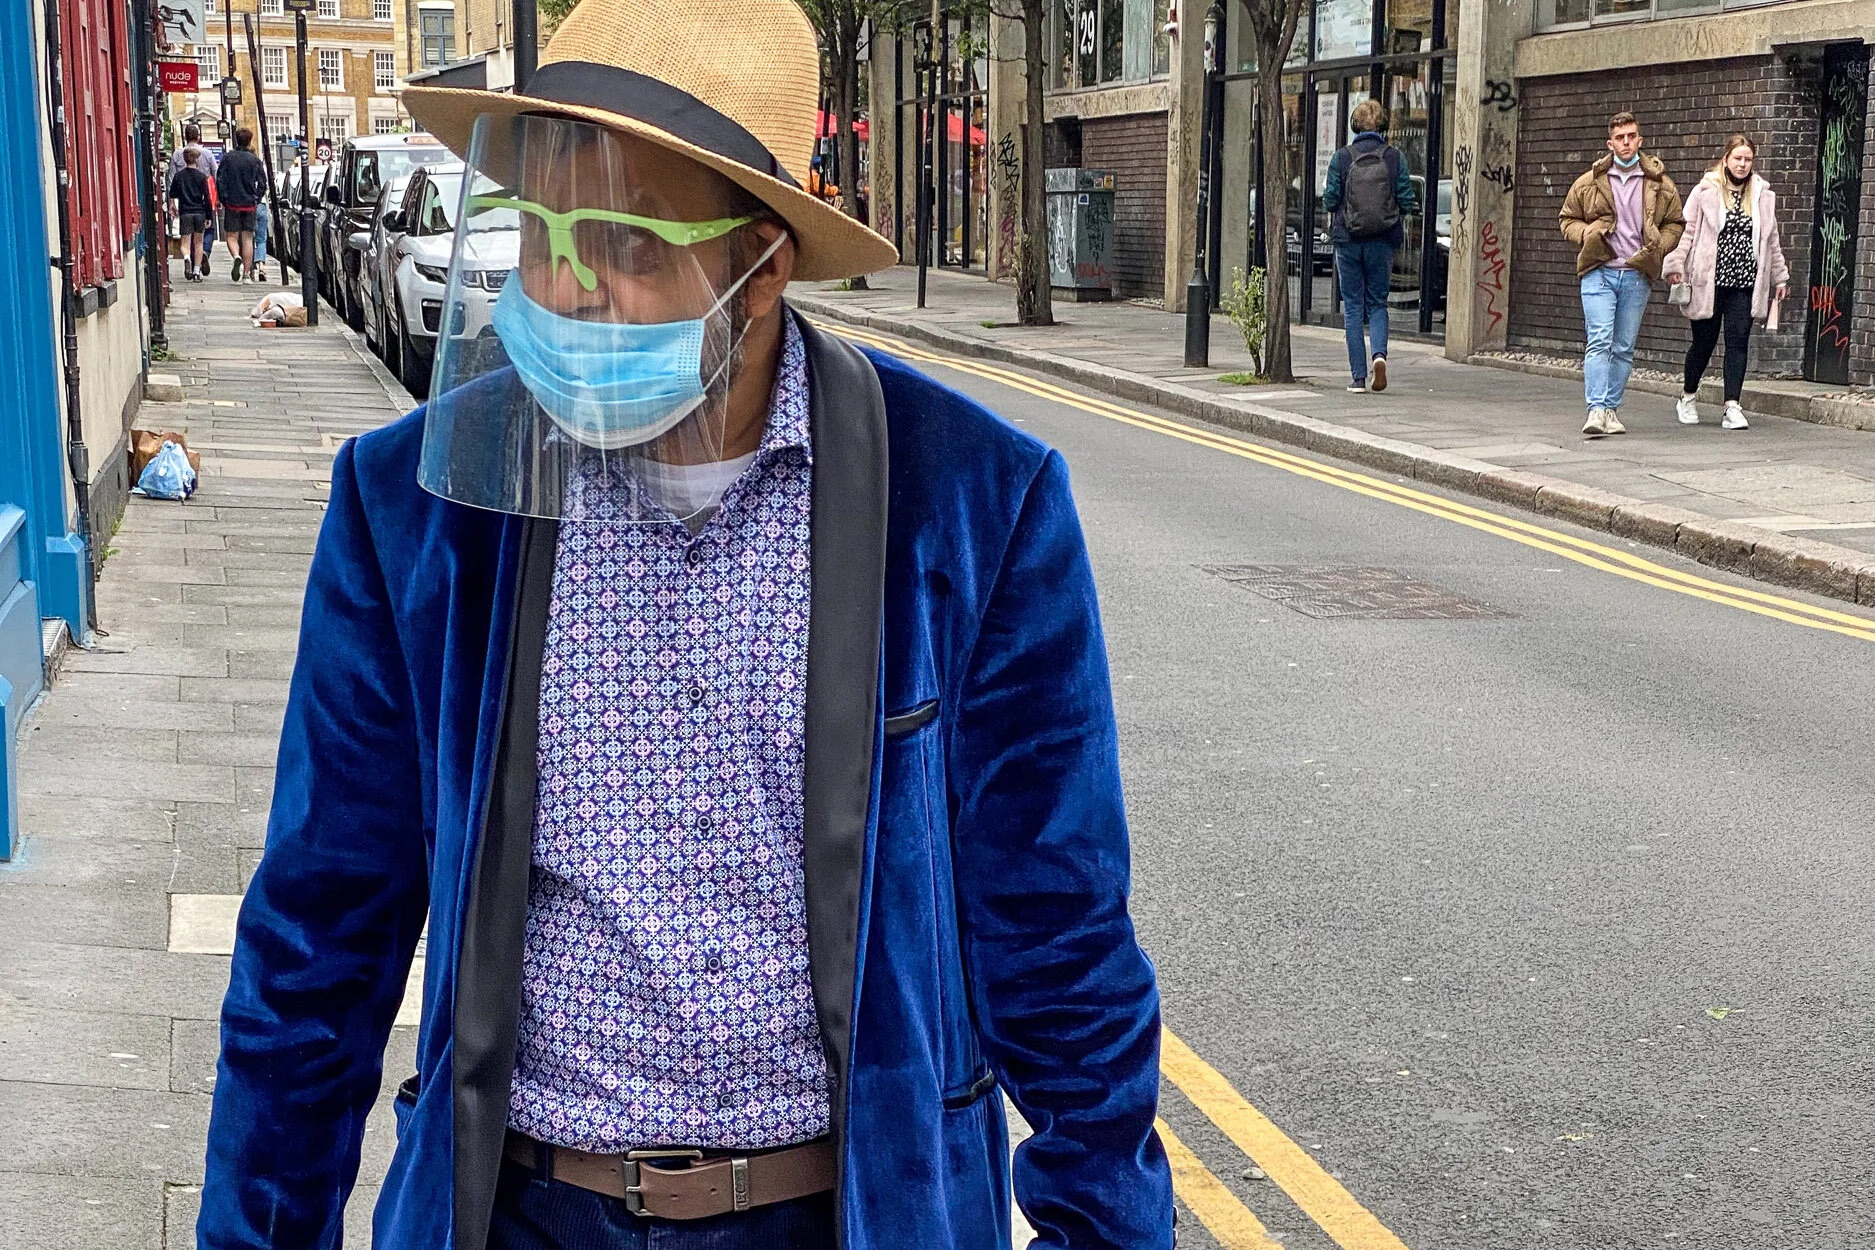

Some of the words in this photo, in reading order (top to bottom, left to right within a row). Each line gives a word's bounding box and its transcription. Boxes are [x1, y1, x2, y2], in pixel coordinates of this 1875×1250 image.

[1080, 10, 1095, 54] 29
[166, 71, 191, 81] nude
[318, 149, 330, 157] 20
